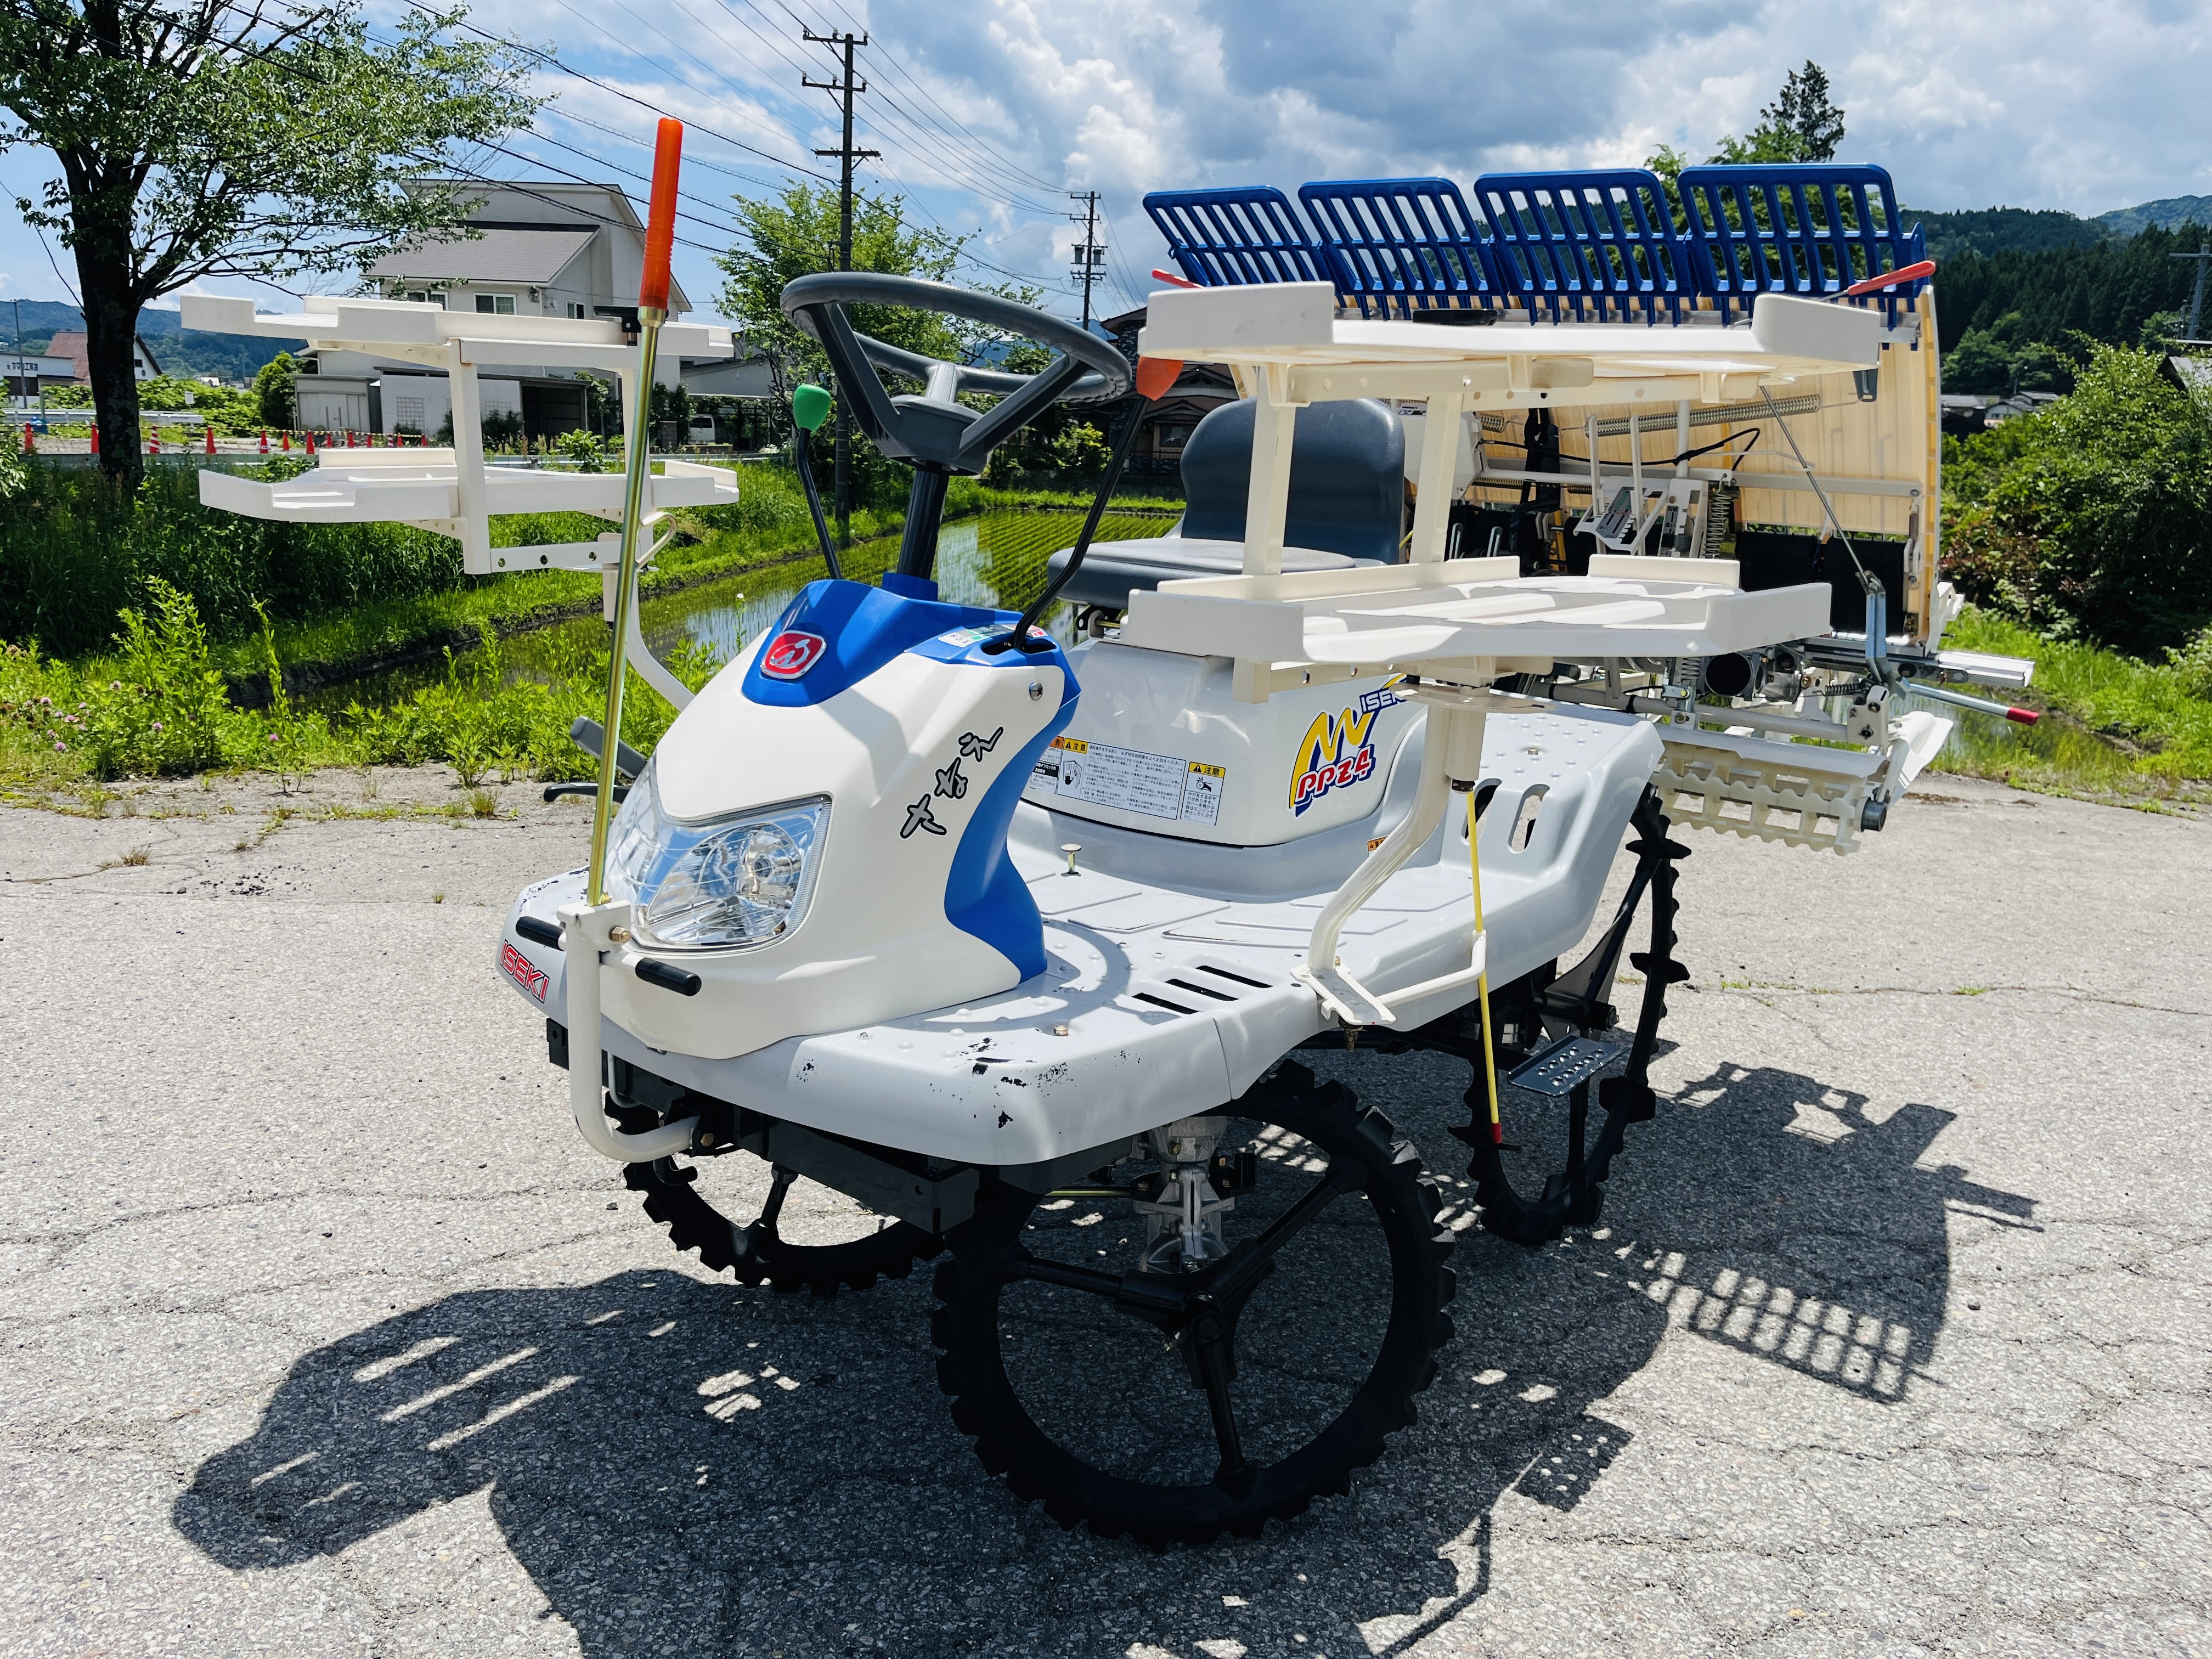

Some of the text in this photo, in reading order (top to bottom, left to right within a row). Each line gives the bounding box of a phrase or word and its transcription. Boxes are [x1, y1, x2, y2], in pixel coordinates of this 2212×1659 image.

[1073, 742, 1086, 751] 注意
[1204, 766, 1220, 776] 注意
[500, 939, 549, 1003] ISEKI
